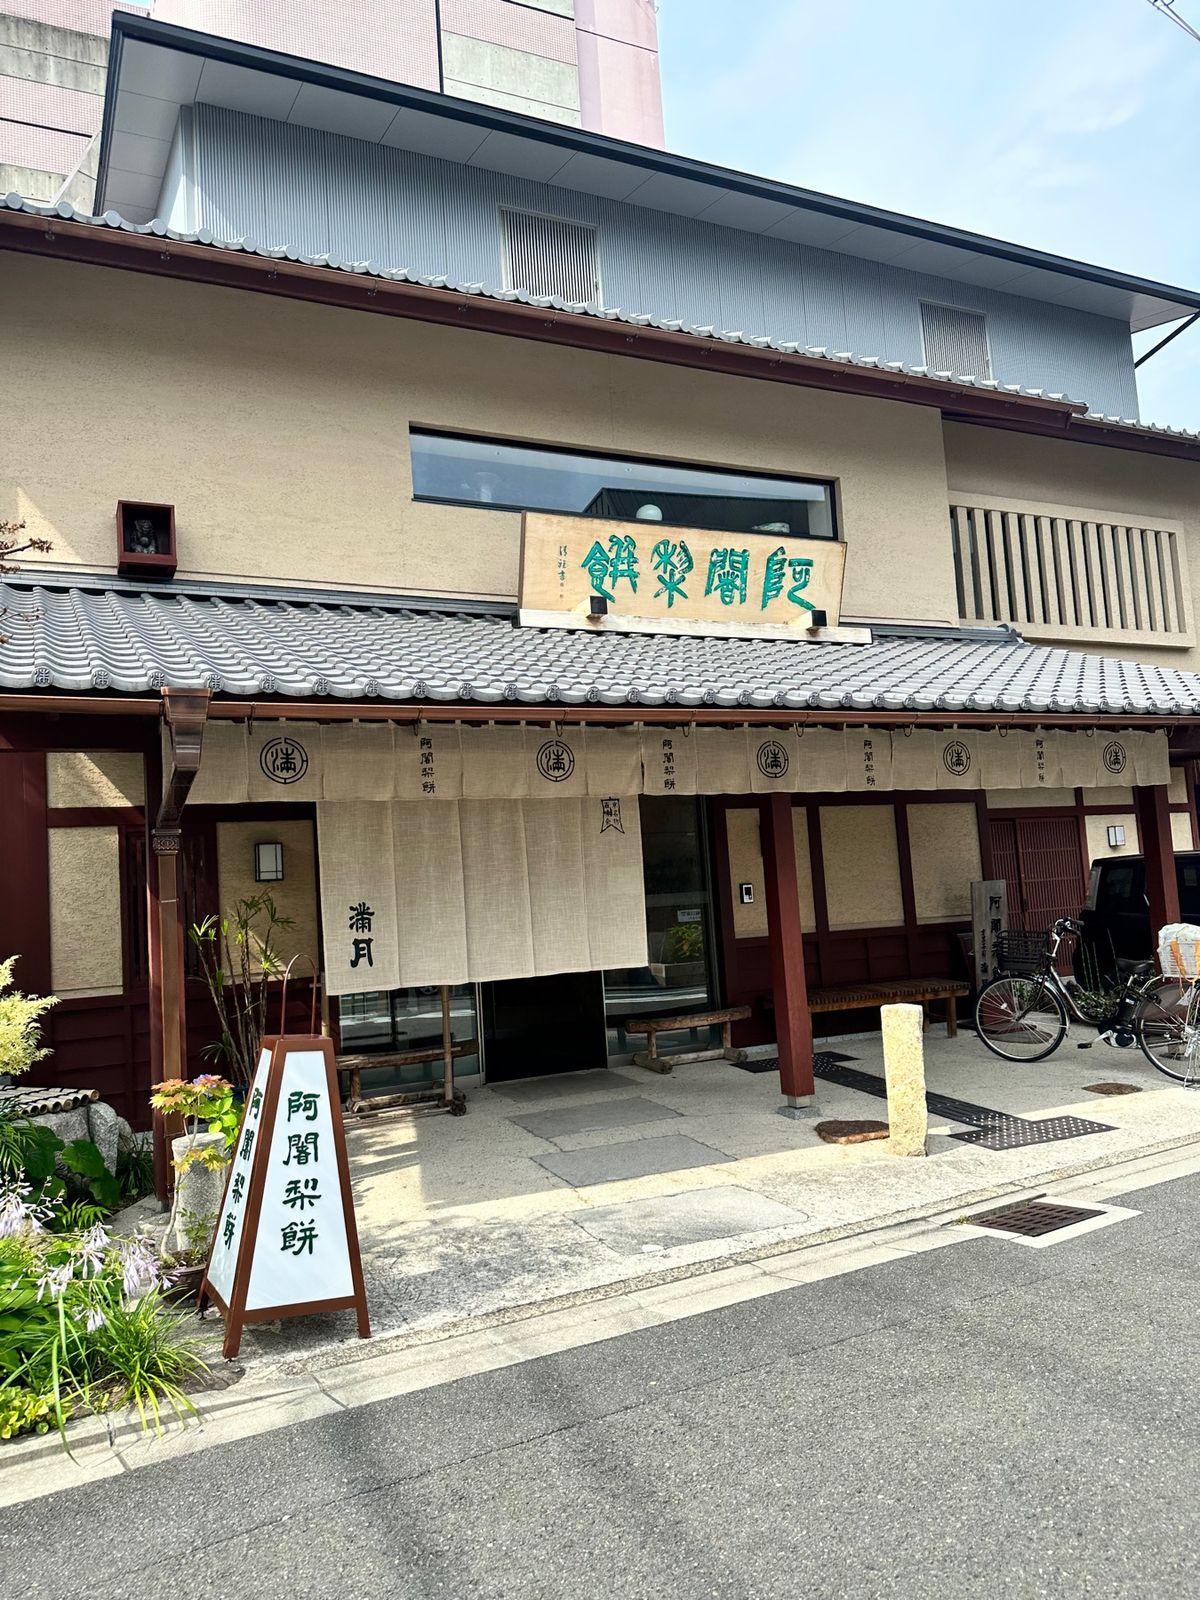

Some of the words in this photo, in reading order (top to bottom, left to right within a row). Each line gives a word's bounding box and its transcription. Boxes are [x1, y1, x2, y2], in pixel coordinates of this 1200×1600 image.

[420, 738, 436, 793] 阿闍梨餅
[662, 739, 676, 790] 阿闍梨餅
[864, 739, 876, 786] 阿闍梨餅
[223, 1088, 263, 1250] 阿闍梨餅
[280, 1091, 321, 1256] 阿闍梨餅
